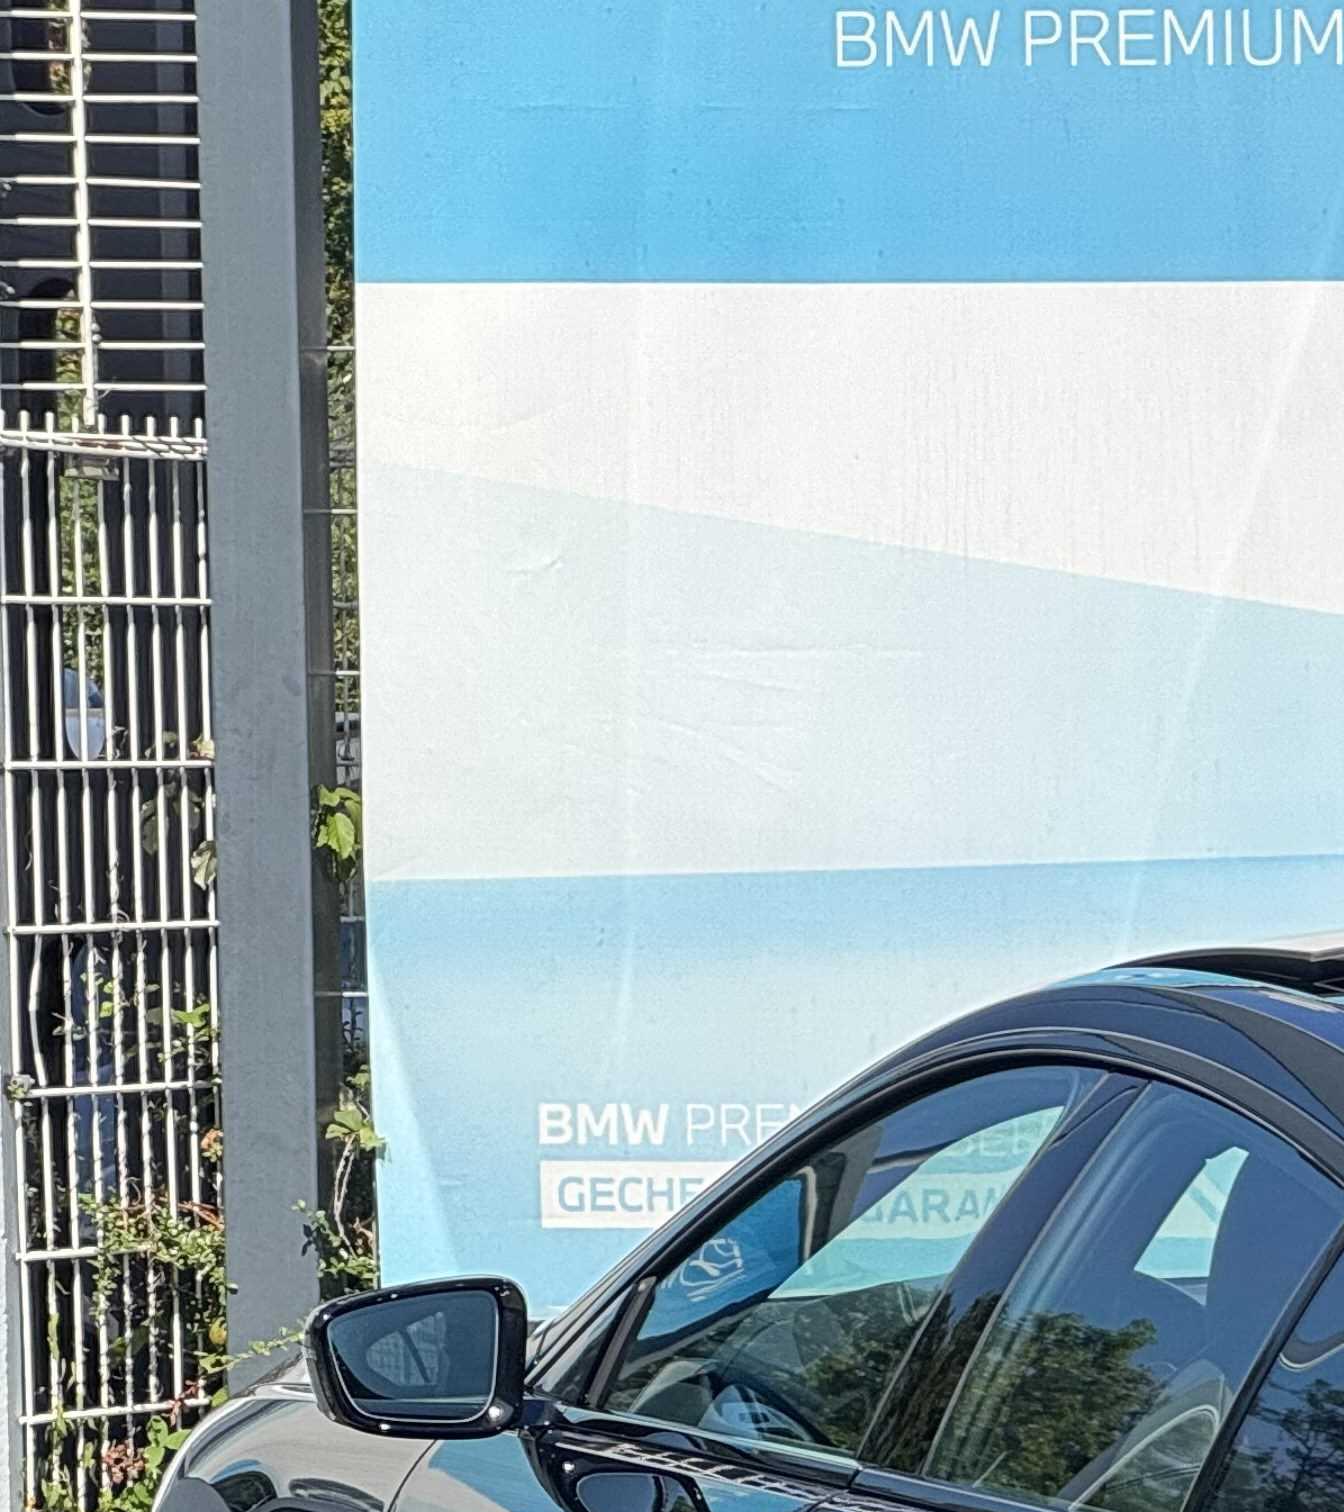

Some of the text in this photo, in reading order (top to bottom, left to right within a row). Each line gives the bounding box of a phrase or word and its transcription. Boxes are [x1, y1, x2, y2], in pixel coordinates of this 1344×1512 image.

[834, 10, 998, 68] BMW
[1024, 8, 1344, 67] PREMIUM
[538, 1103, 803, 1146] BMW PRE
